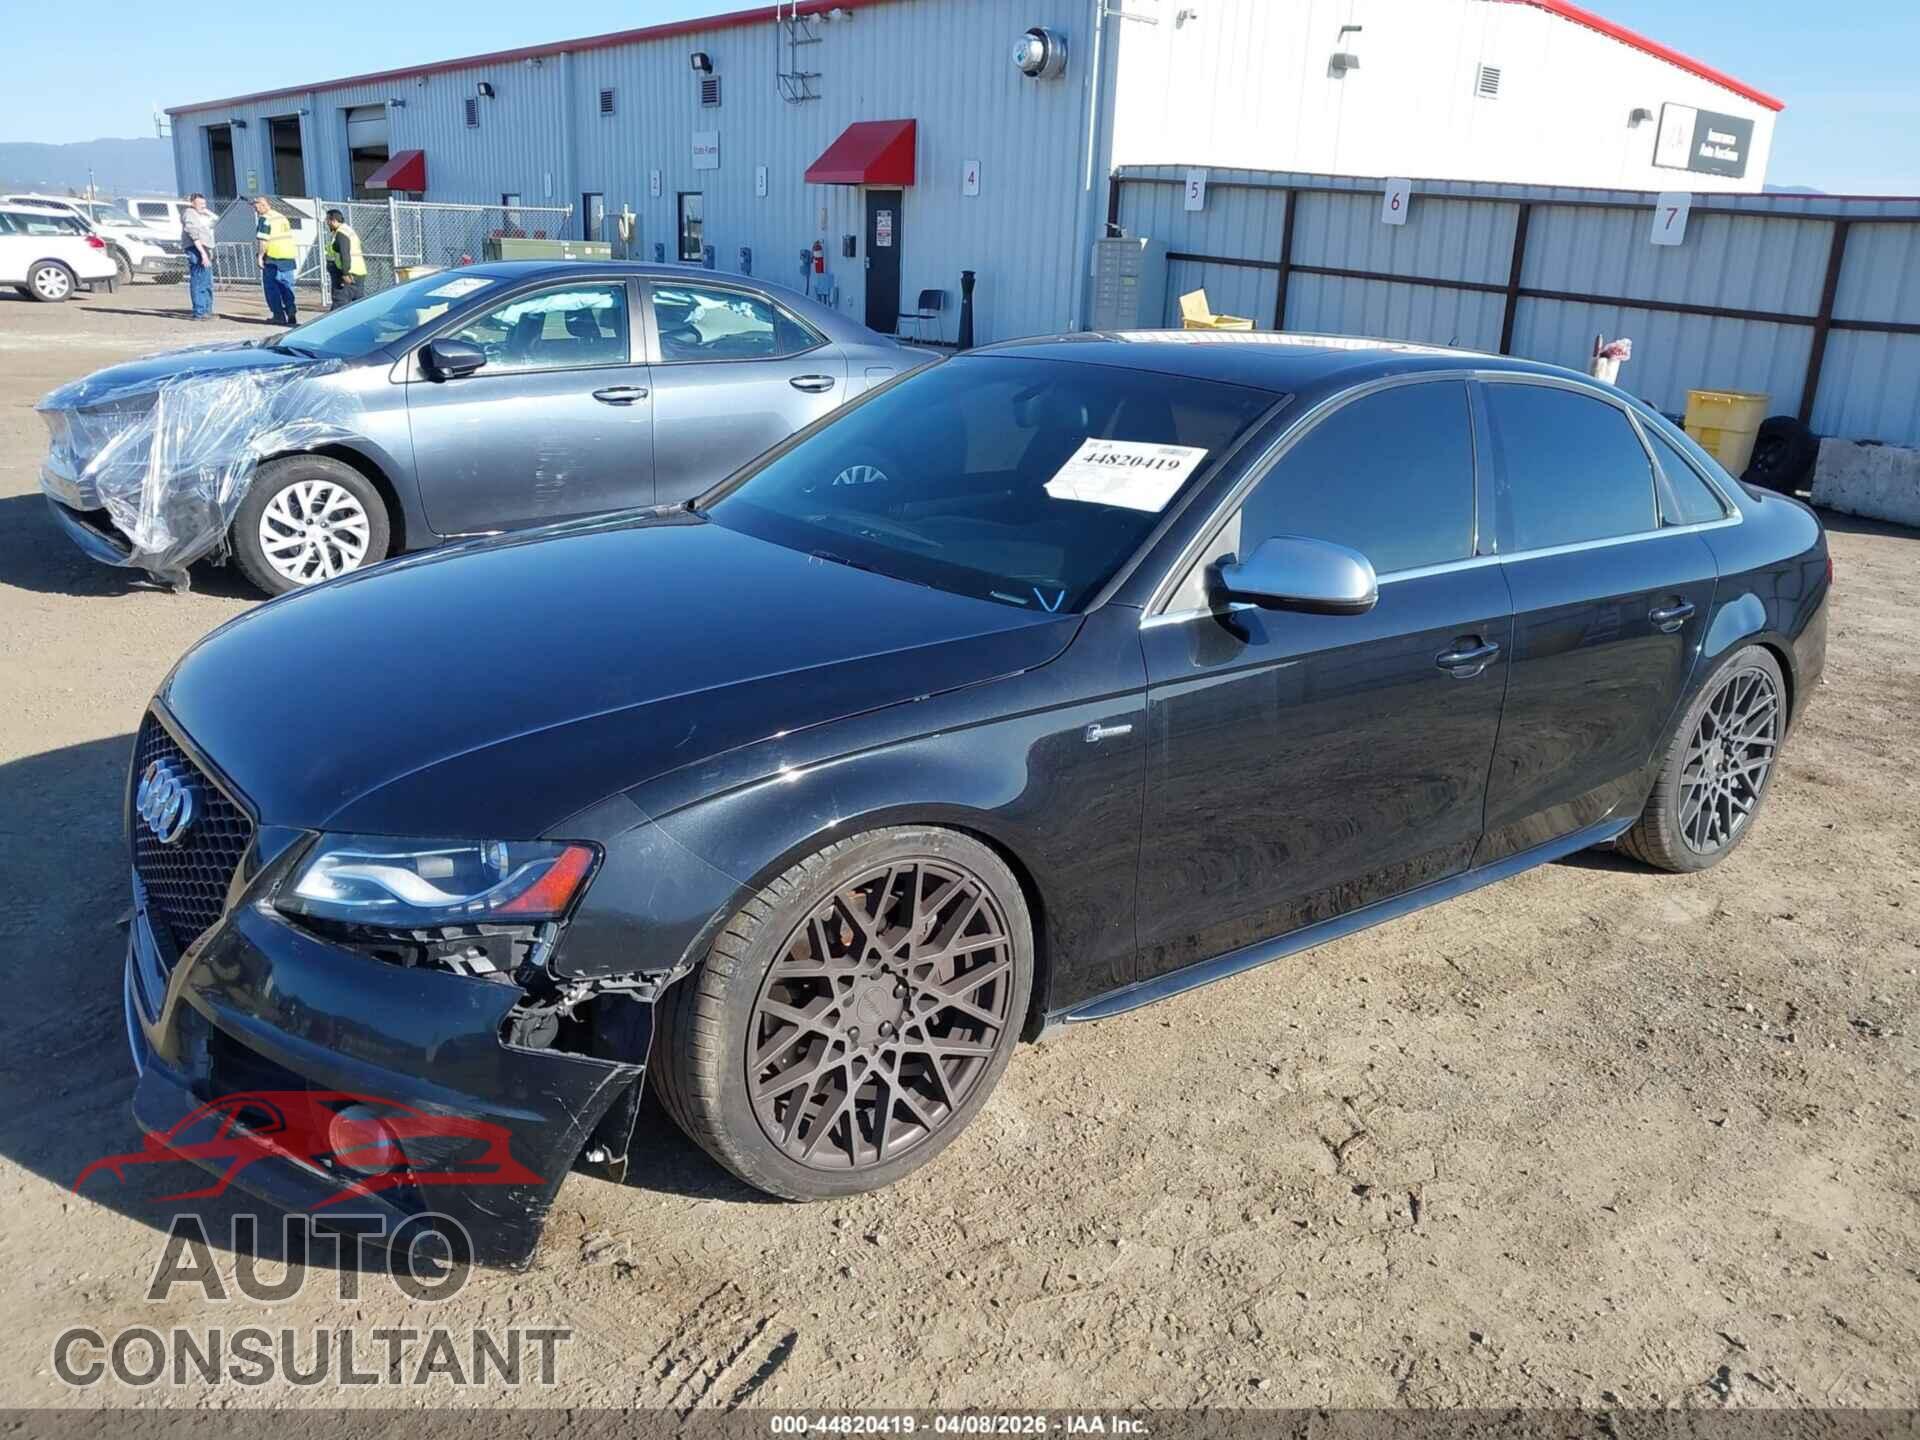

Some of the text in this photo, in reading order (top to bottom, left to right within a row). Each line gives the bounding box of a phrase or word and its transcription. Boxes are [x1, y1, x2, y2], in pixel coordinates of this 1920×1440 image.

[967, 171, 975, 185] 4
[1191, 182, 1199, 199] 5
[1391, 192, 1401, 210] 6
[1666, 207, 1678, 230] 7
[1083, 452, 1181, 471] 44820419
